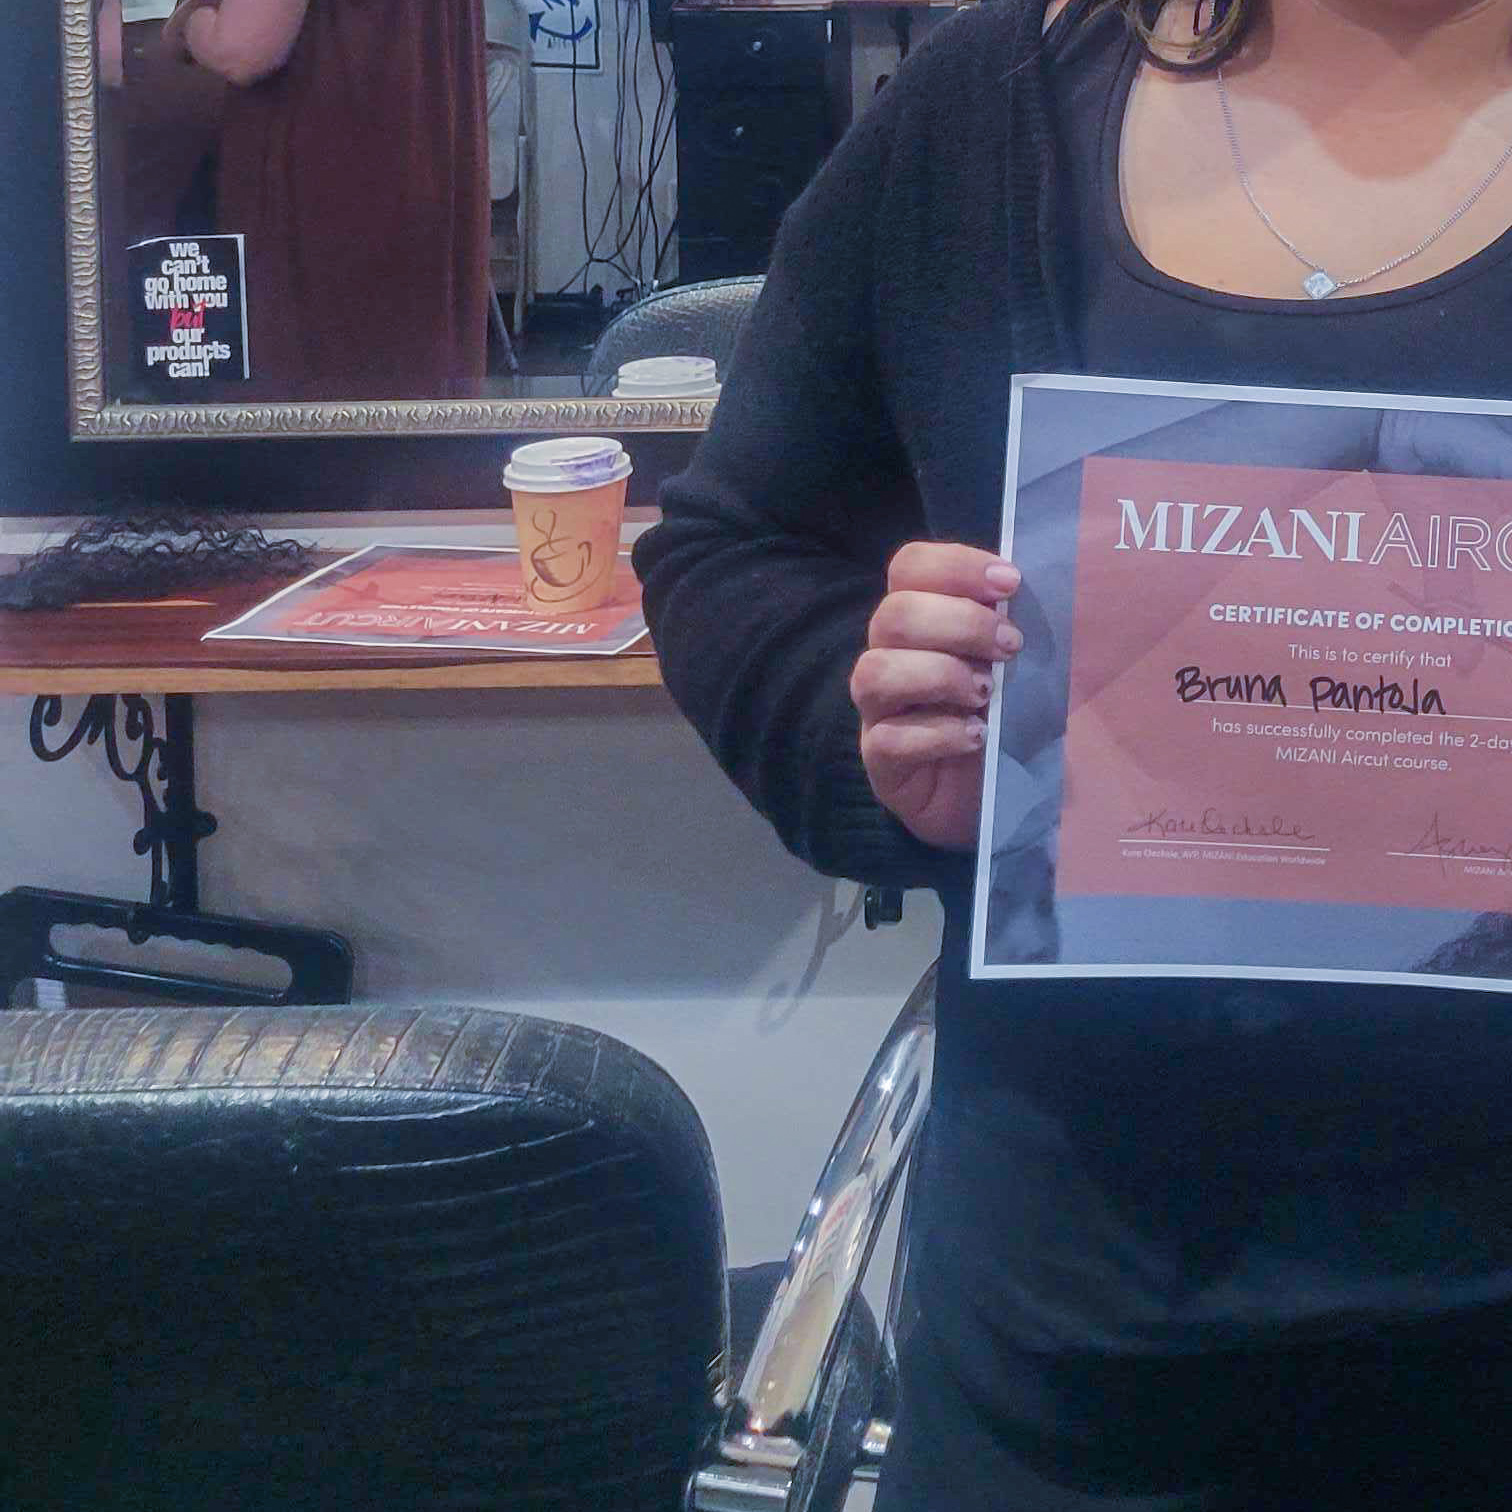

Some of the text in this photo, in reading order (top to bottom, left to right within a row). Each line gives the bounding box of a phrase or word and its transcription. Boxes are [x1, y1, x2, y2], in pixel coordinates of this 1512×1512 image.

[168, 241, 200, 258] we
[161, 255, 210, 276] can't
[173, 273, 228, 292] home
[192, 292, 229, 313] you
[172, 328, 205, 344] our
[146, 340, 232, 367] products
[168, 360, 211, 378] can!
[1115, 498, 1367, 563] MIZANI
[1208, 603, 1351, 630] CERTIFICATE
[1354, 612, 1385, 630] OF
[1288, 644, 1452, 669] This is to certify that
[1174, 666, 1287, 708] Bruna
[1211, 717, 1242, 734] has
[1246, 721, 1342, 742] successfully
[1345, 728, 1434, 747] completed
[1438, 731, 1465, 747] the
[1275, 746, 1453, 772] MIZANI Aircut course.
